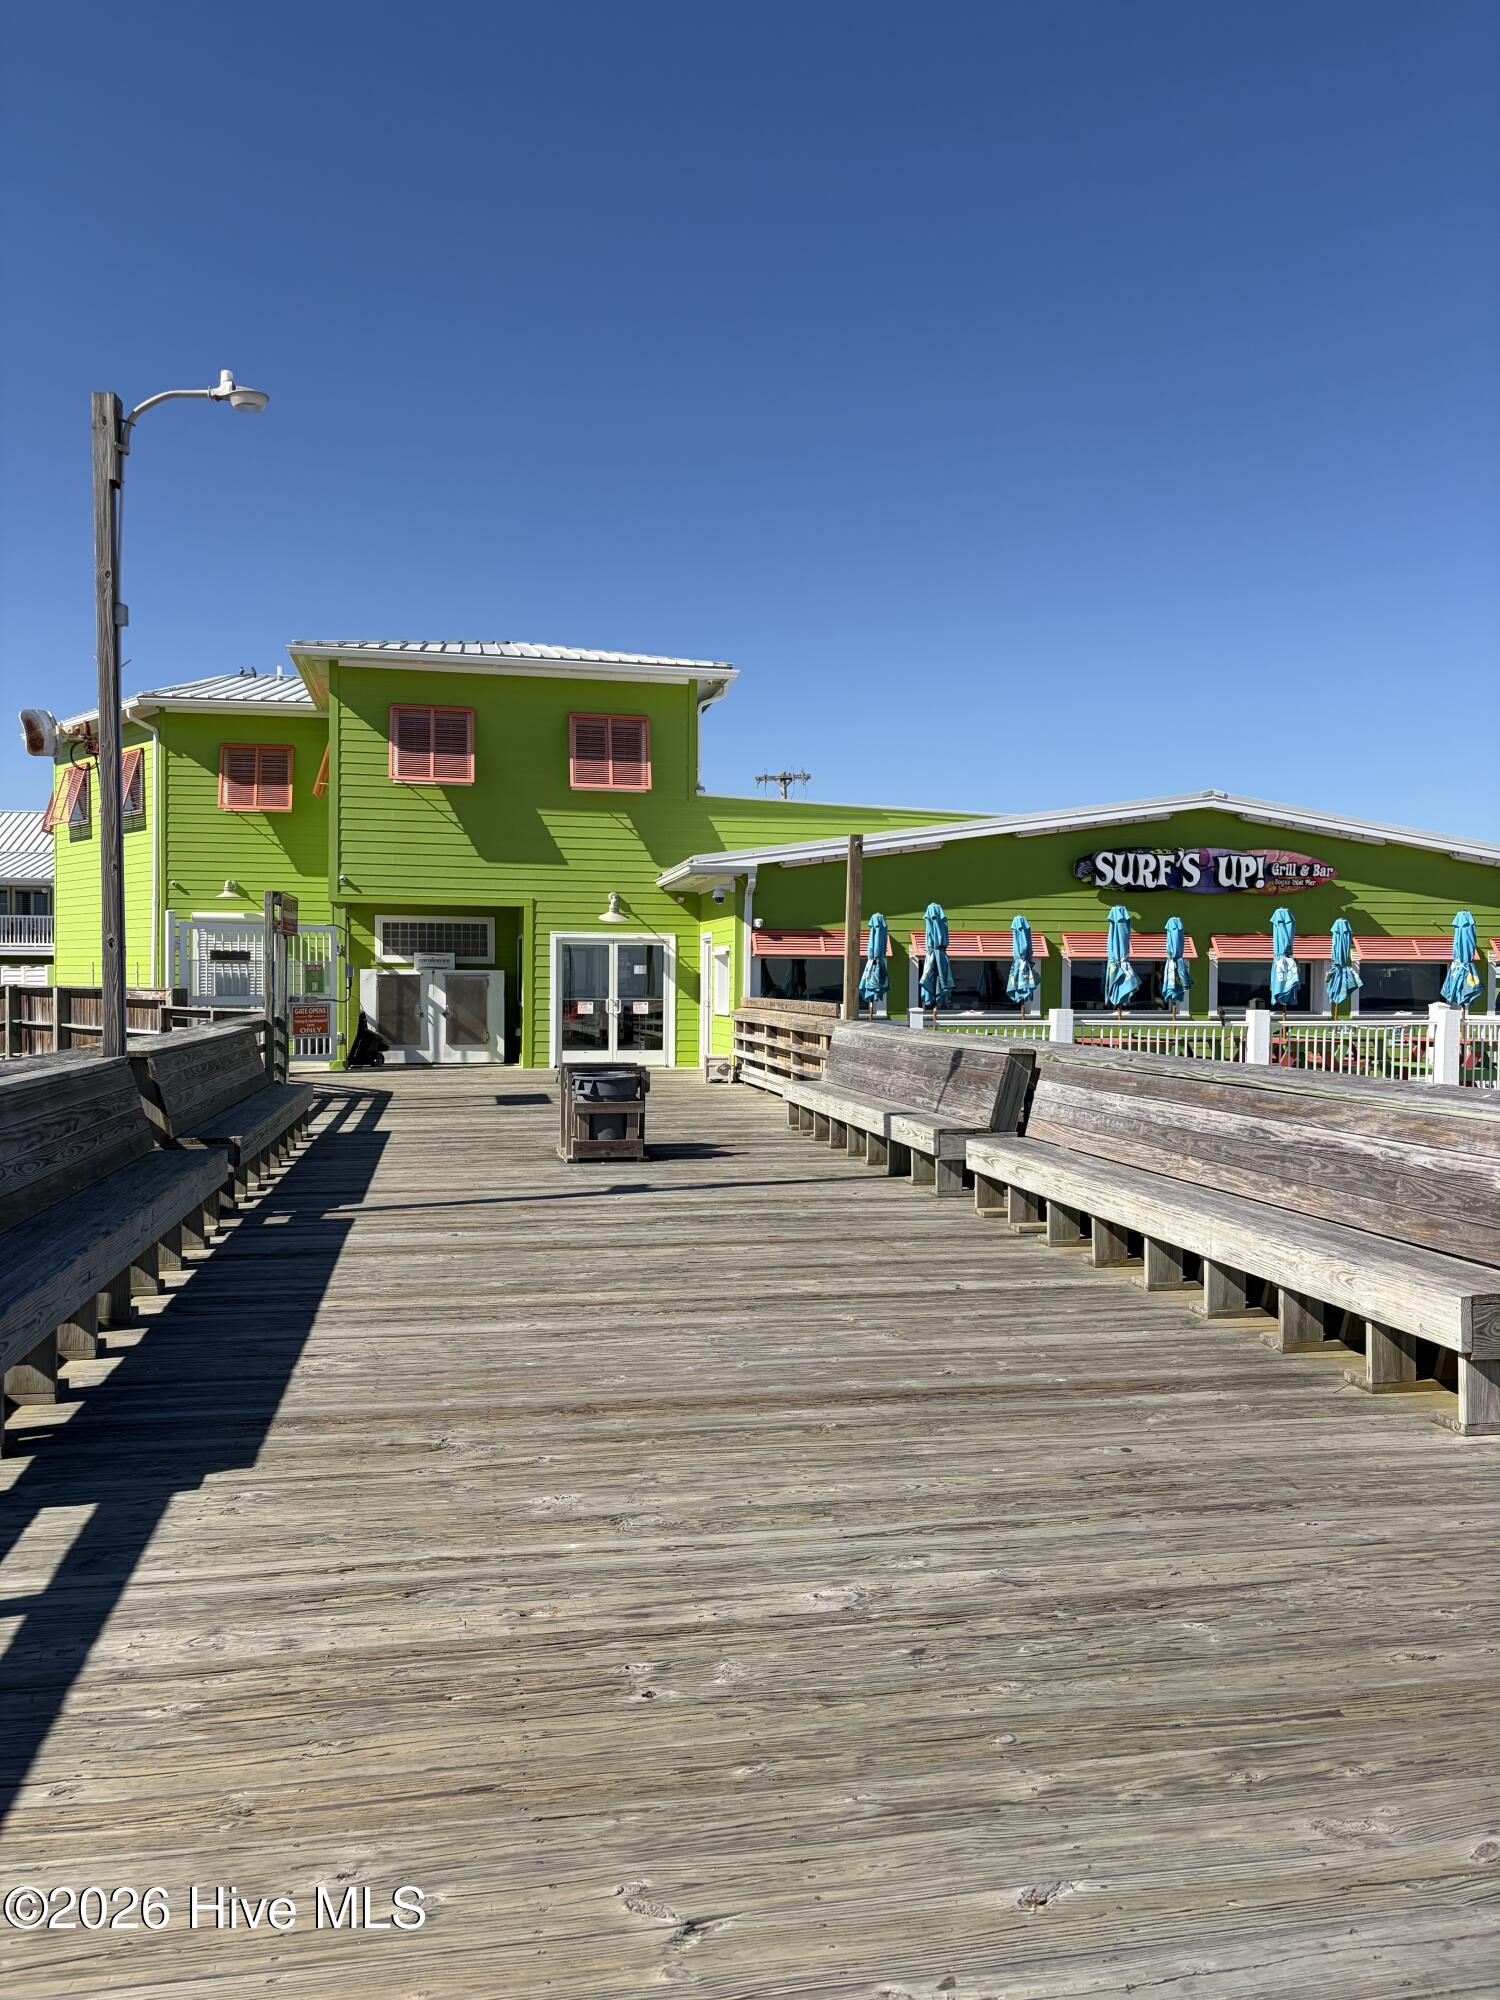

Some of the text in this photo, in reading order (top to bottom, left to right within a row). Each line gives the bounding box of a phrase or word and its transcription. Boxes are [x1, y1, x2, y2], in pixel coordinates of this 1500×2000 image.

[1095, 848, 1265, 889] SURF'S UP!
[1271, 862, 1334, 877] Grill & Bar
